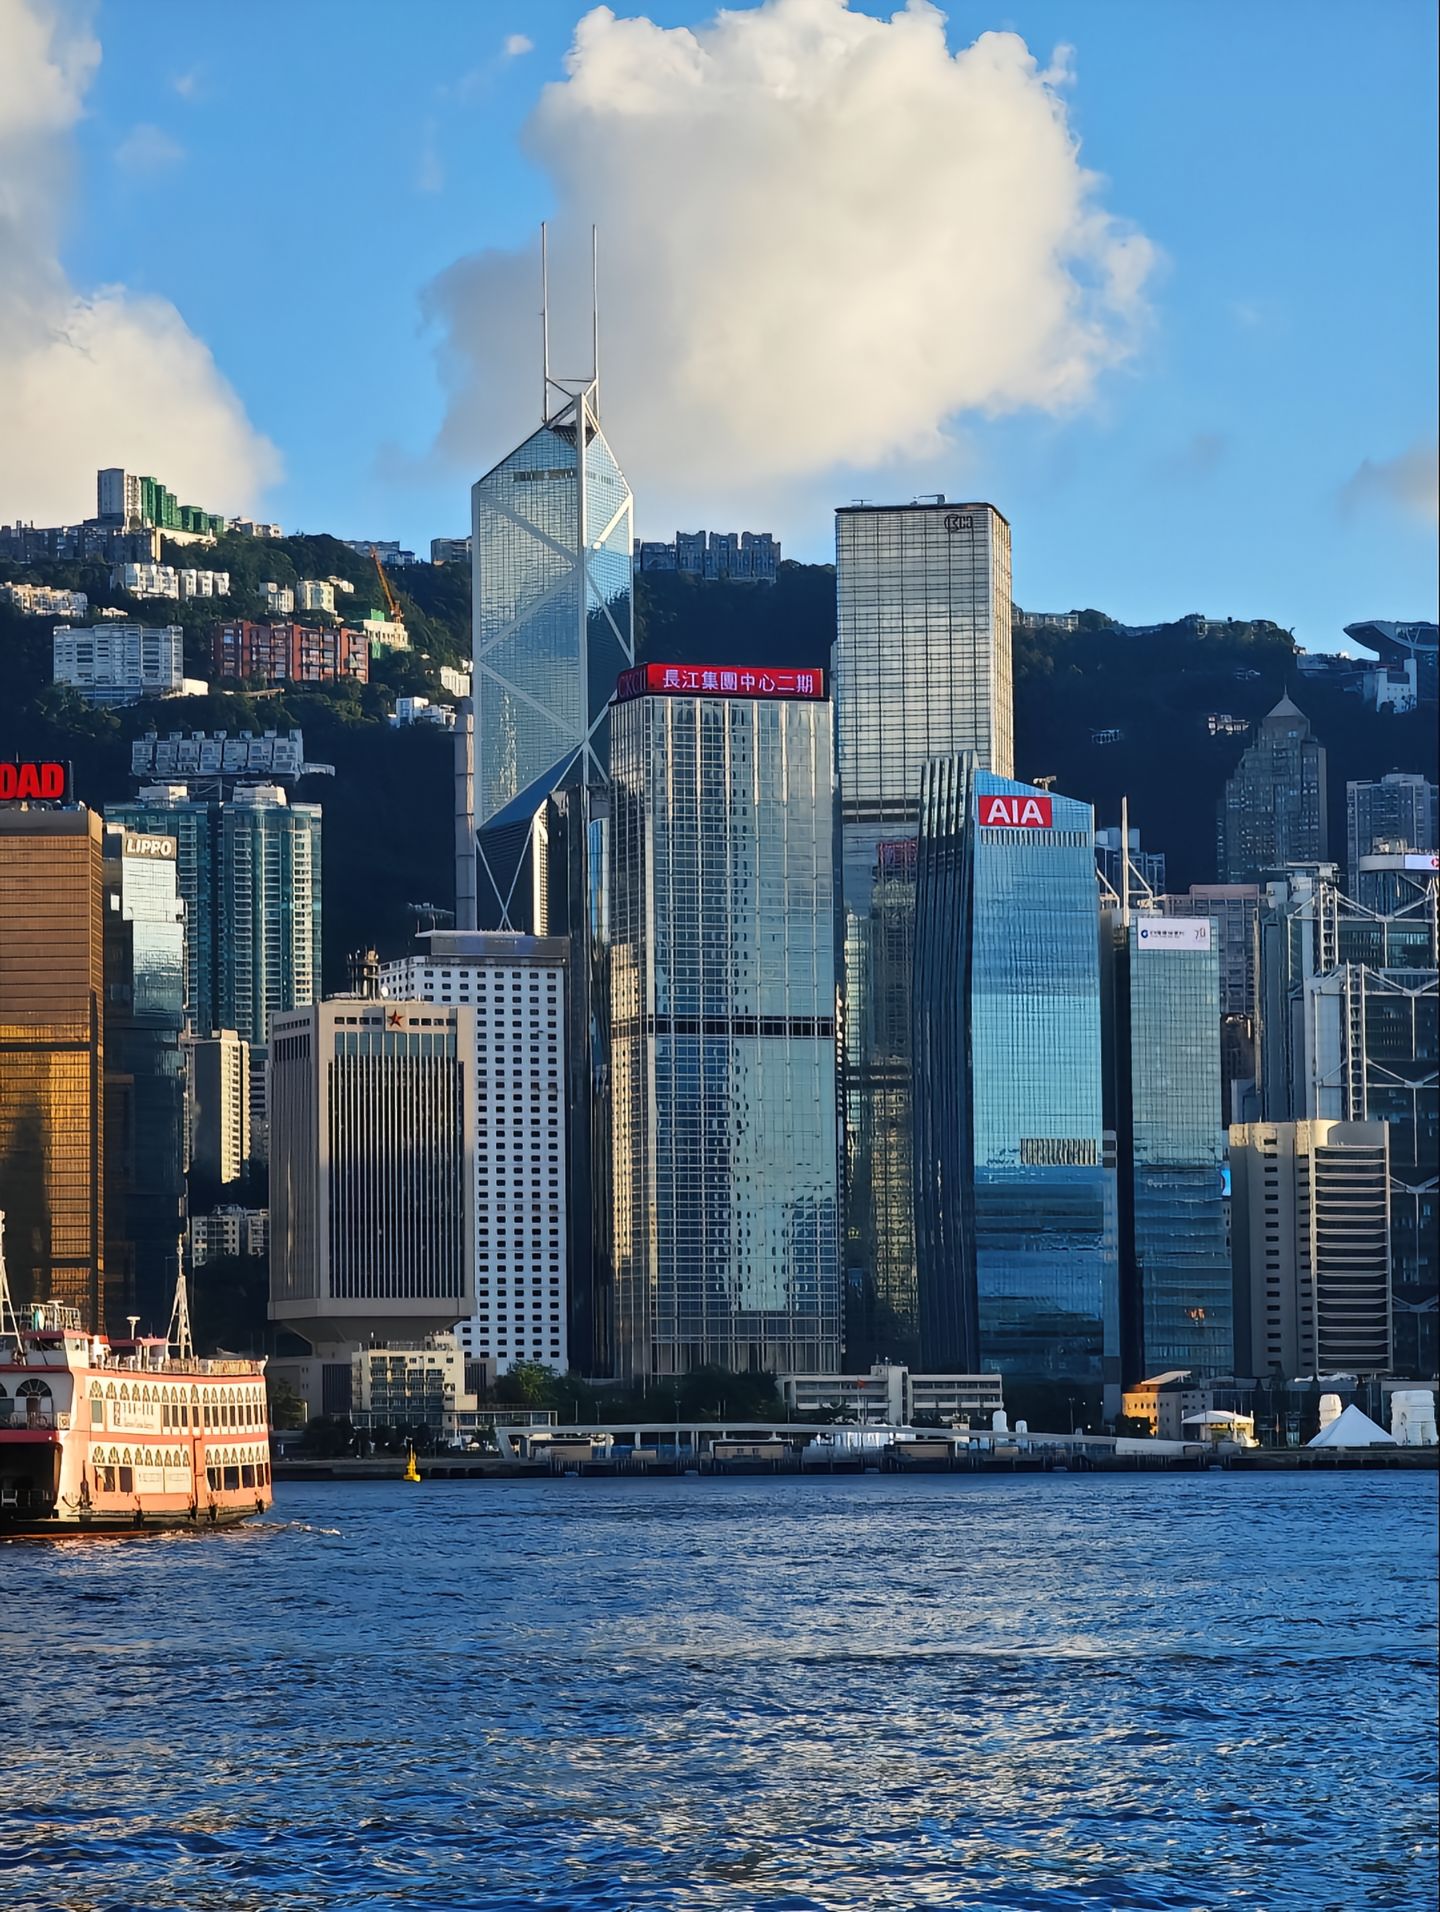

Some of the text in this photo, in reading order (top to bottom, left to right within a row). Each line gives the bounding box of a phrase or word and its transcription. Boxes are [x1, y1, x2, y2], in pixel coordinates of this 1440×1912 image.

[662, 669, 813, 694] 長江集團中心二期
[987, 798, 1044, 825] AIA
[127, 838, 172, 856] LIPPO
